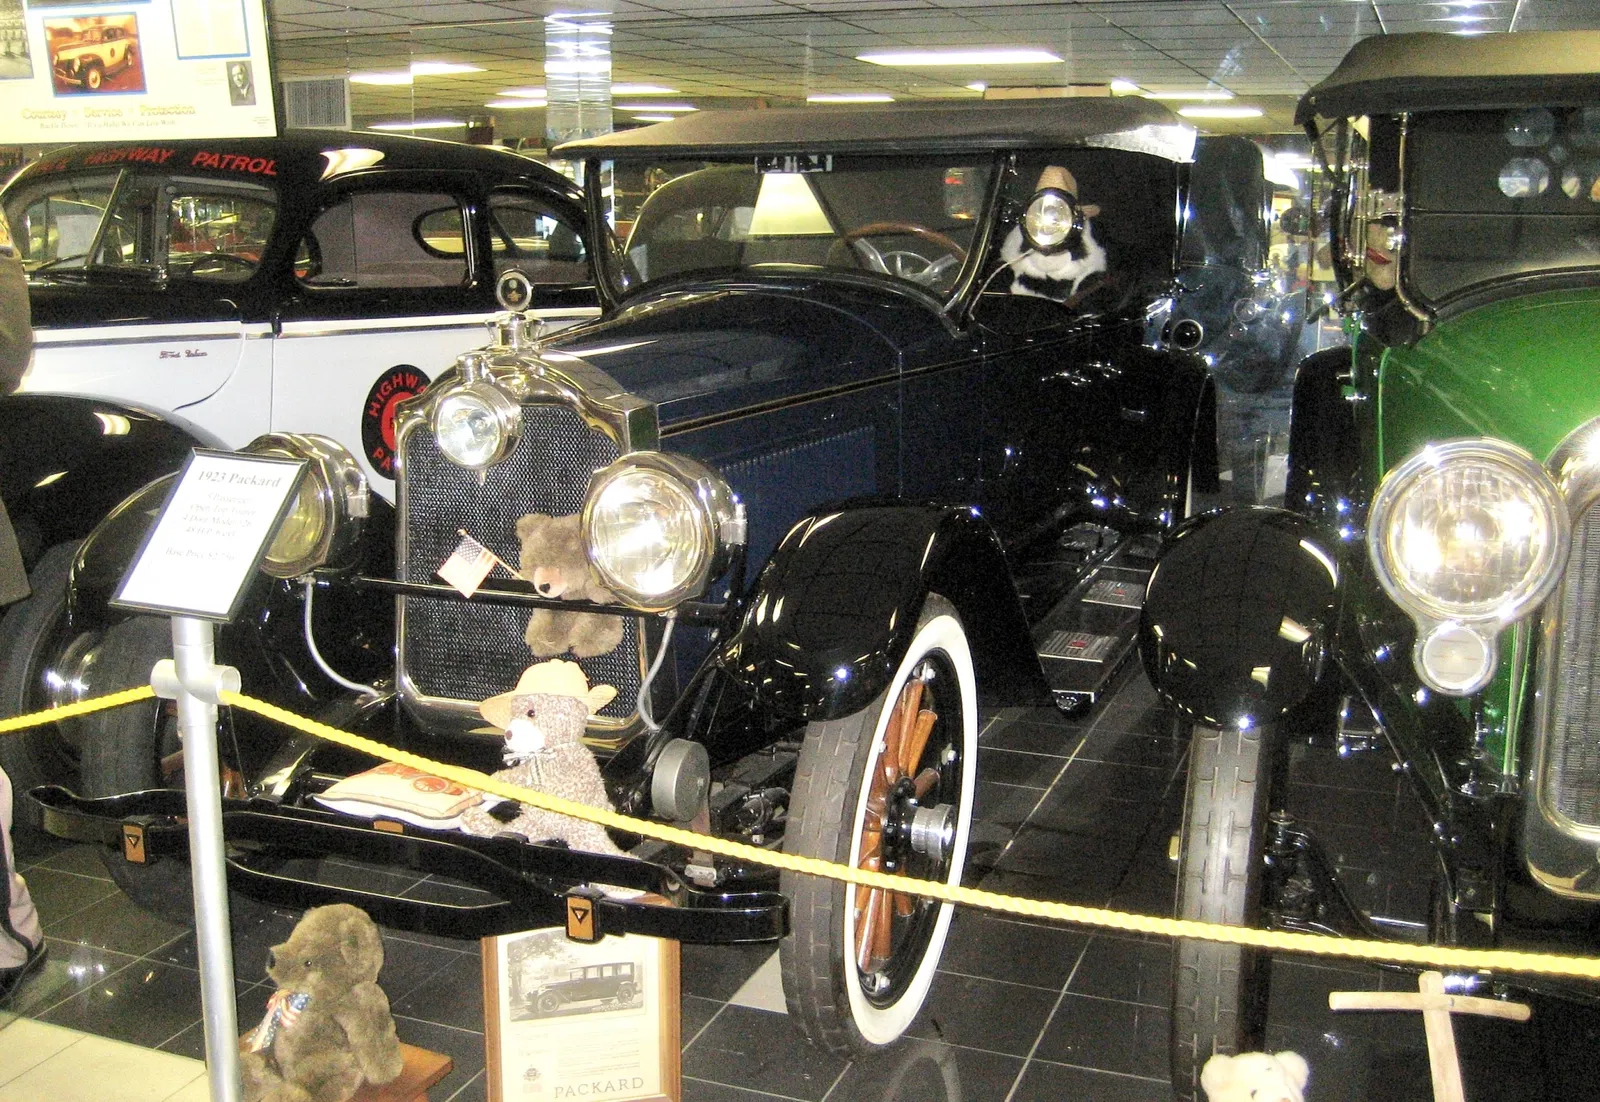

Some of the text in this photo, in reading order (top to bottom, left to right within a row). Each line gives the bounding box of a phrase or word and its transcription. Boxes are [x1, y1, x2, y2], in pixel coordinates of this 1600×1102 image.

[84, 106, 123, 118] Service
[139, 104, 196, 116] Protection
[84, 148, 175, 165] HIGHWAY
[191, 151, 277, 176] PATROL
[369, 372, 428, 417] HIGHWA
[198, 470, 282, 488] 1923 Packard
[554, 1077, 645, 1099] PACKARD
